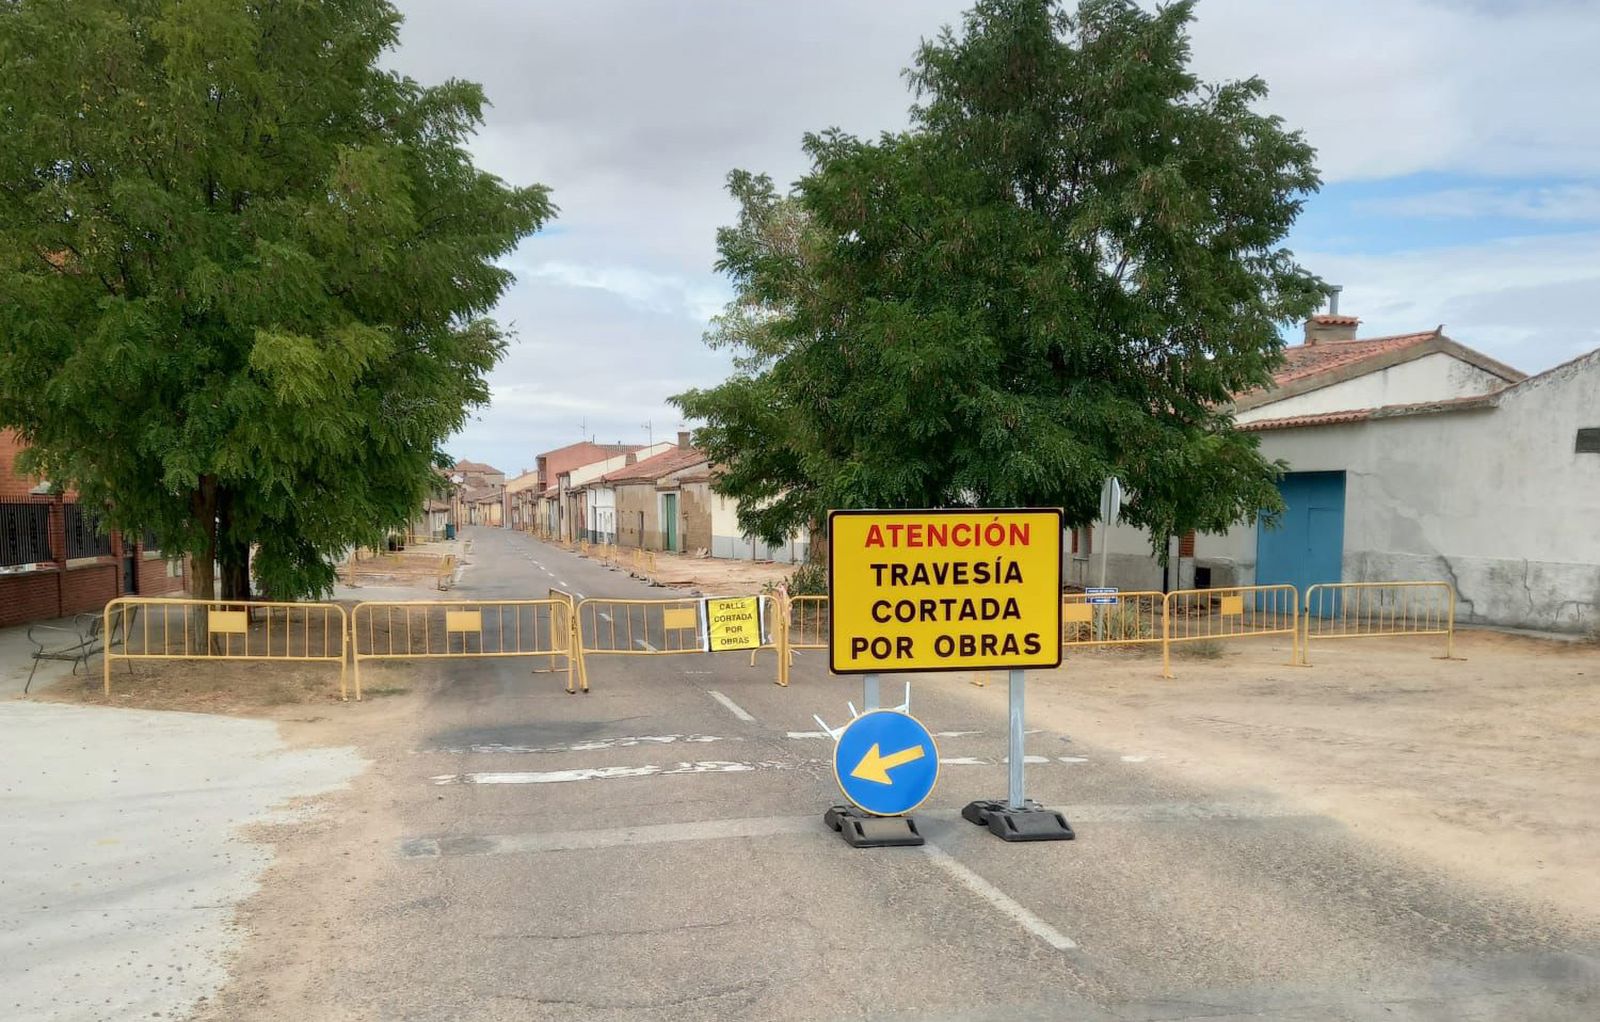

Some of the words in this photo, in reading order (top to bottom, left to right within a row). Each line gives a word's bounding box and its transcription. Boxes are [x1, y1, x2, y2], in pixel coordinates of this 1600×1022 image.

[865, 516, 1030, 548] ATENCIÓN
[870, 556, 1024, 587] TRAVESÍA
[719, 602, 746, 610] CALLE
[871, 597, 1021, 624] CORTADA
[714, 613, 753, 623] CORTADA
[725, 625, 743, 633] POR
[720, 636, 750, 645] OBRAS
[851, 636, 914, 660] POR
[934, 633, 1041, 658] OBRAS
